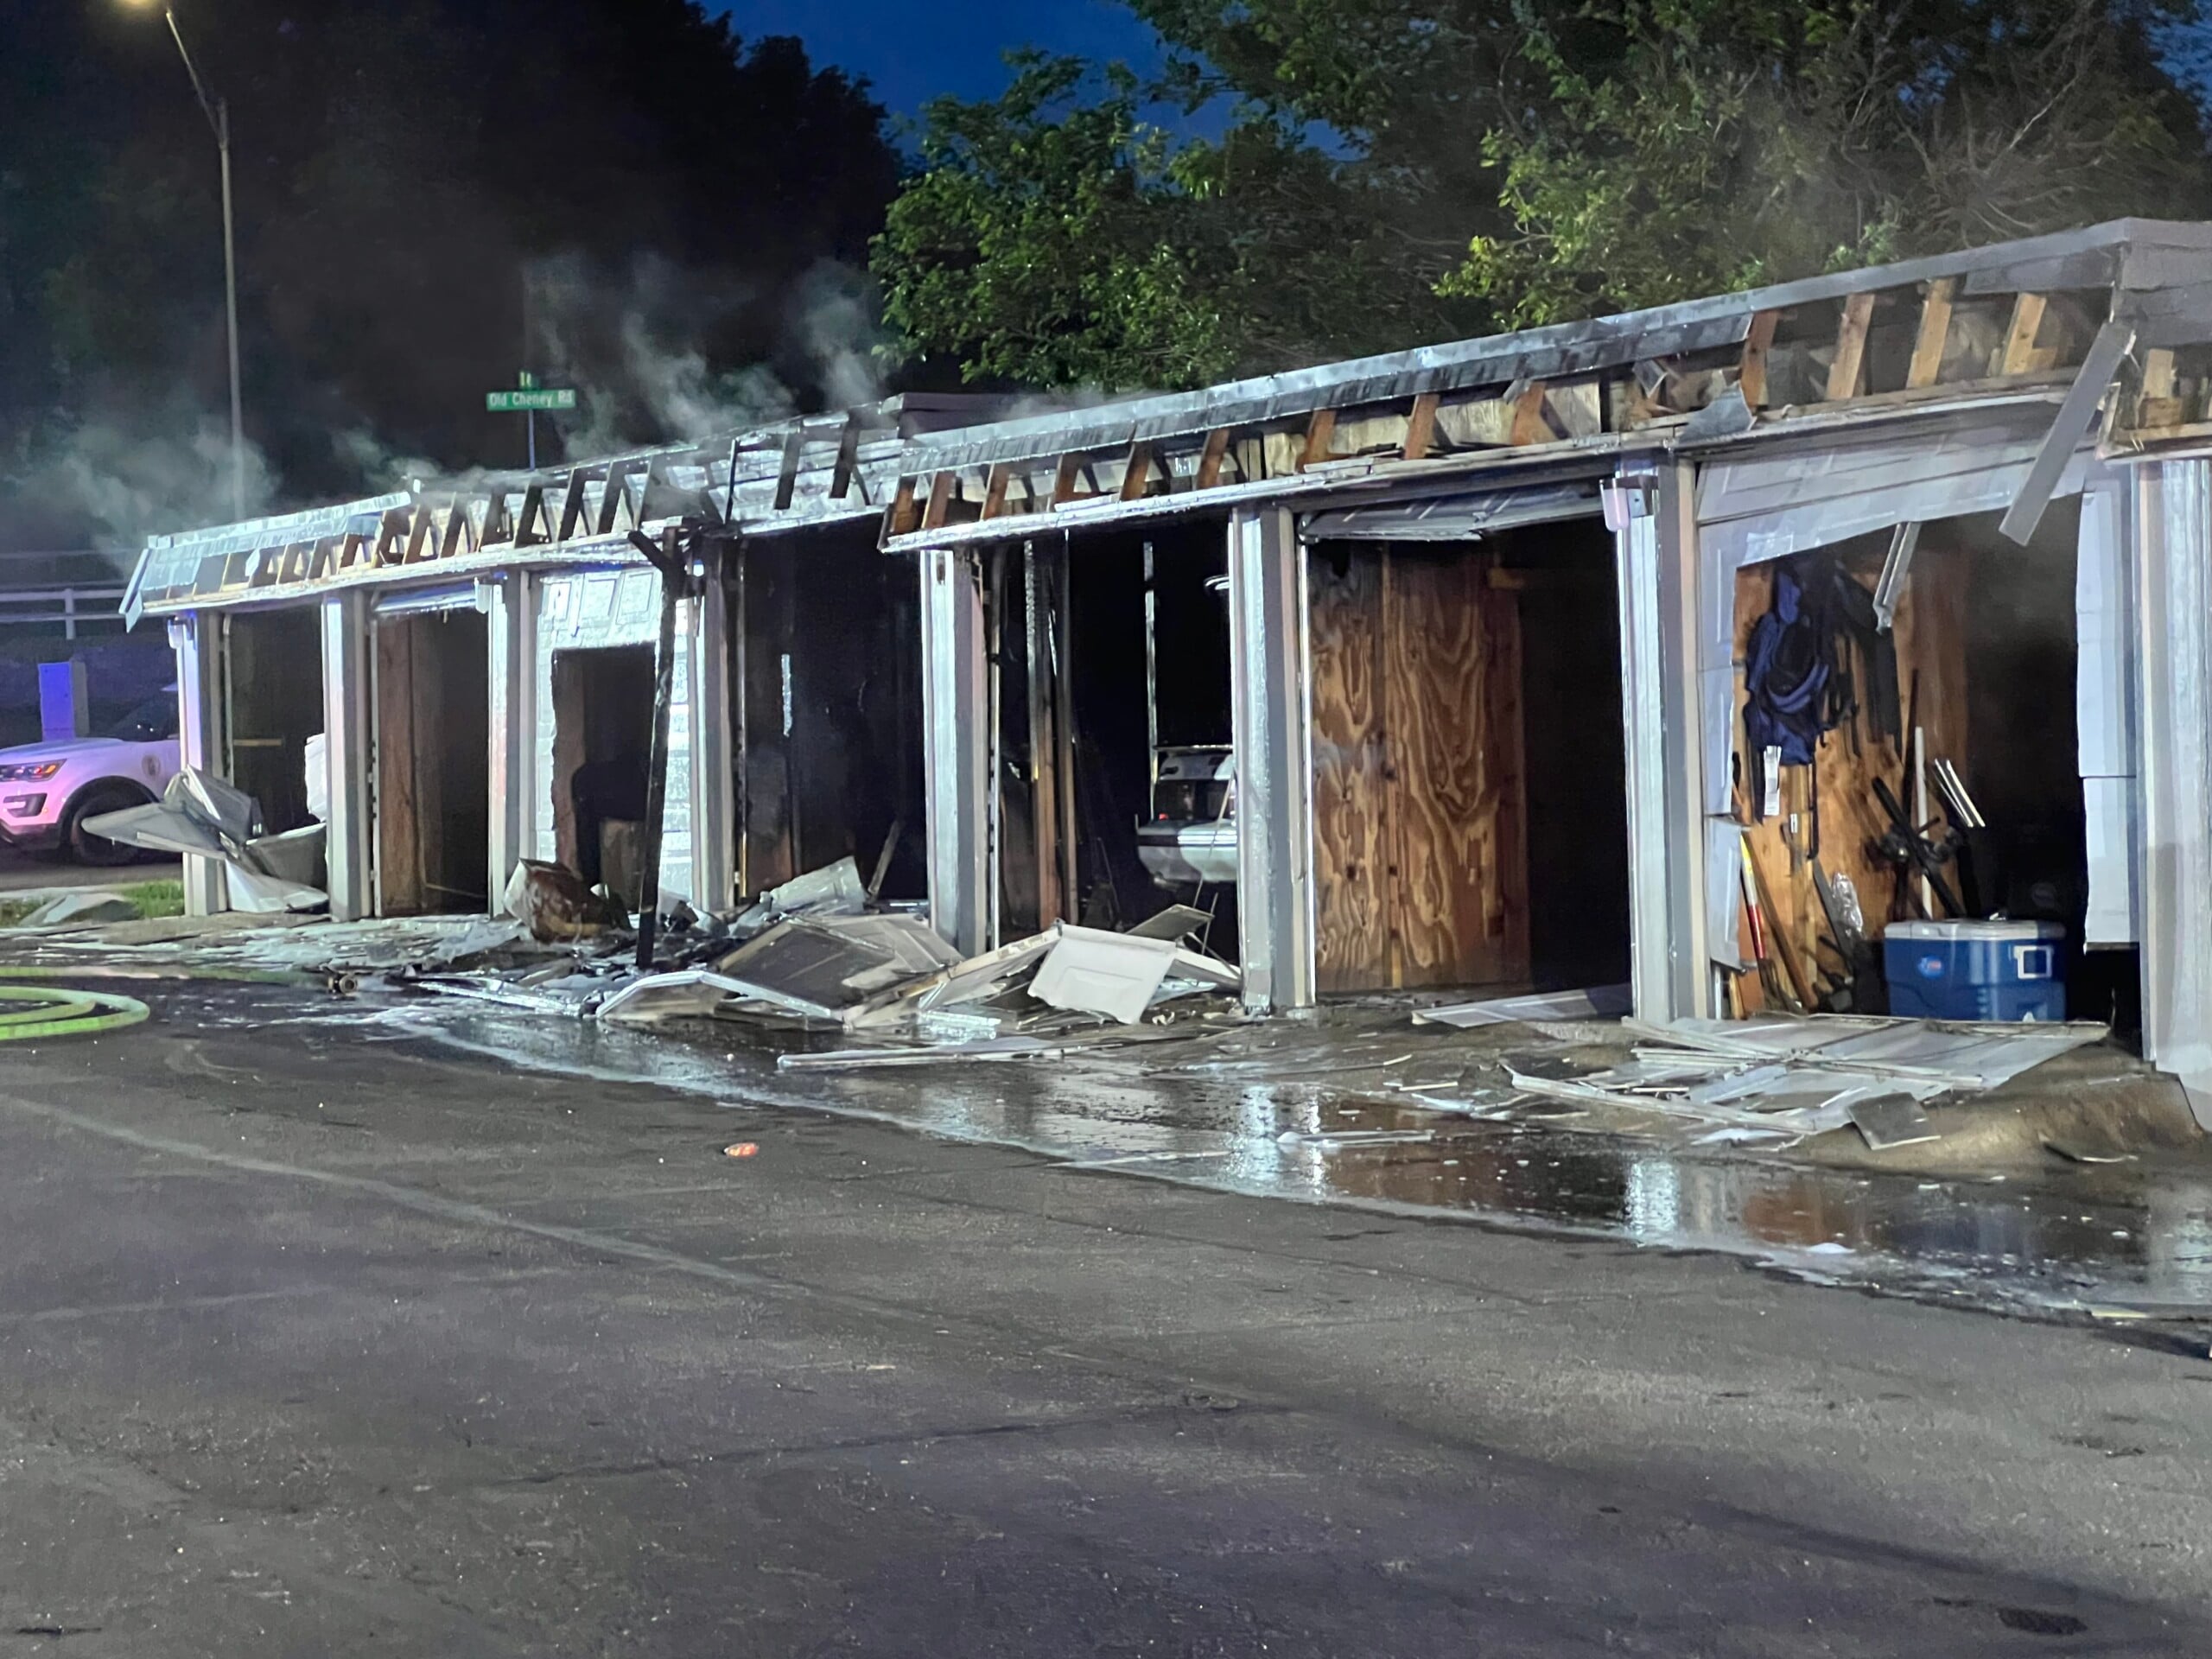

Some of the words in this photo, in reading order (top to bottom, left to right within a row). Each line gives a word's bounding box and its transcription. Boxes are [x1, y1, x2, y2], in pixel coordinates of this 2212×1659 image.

[489, 392, 507, 407] Old
[512, 391, 554, 408] Cheney
[558, 391, 573, 403] Rd
